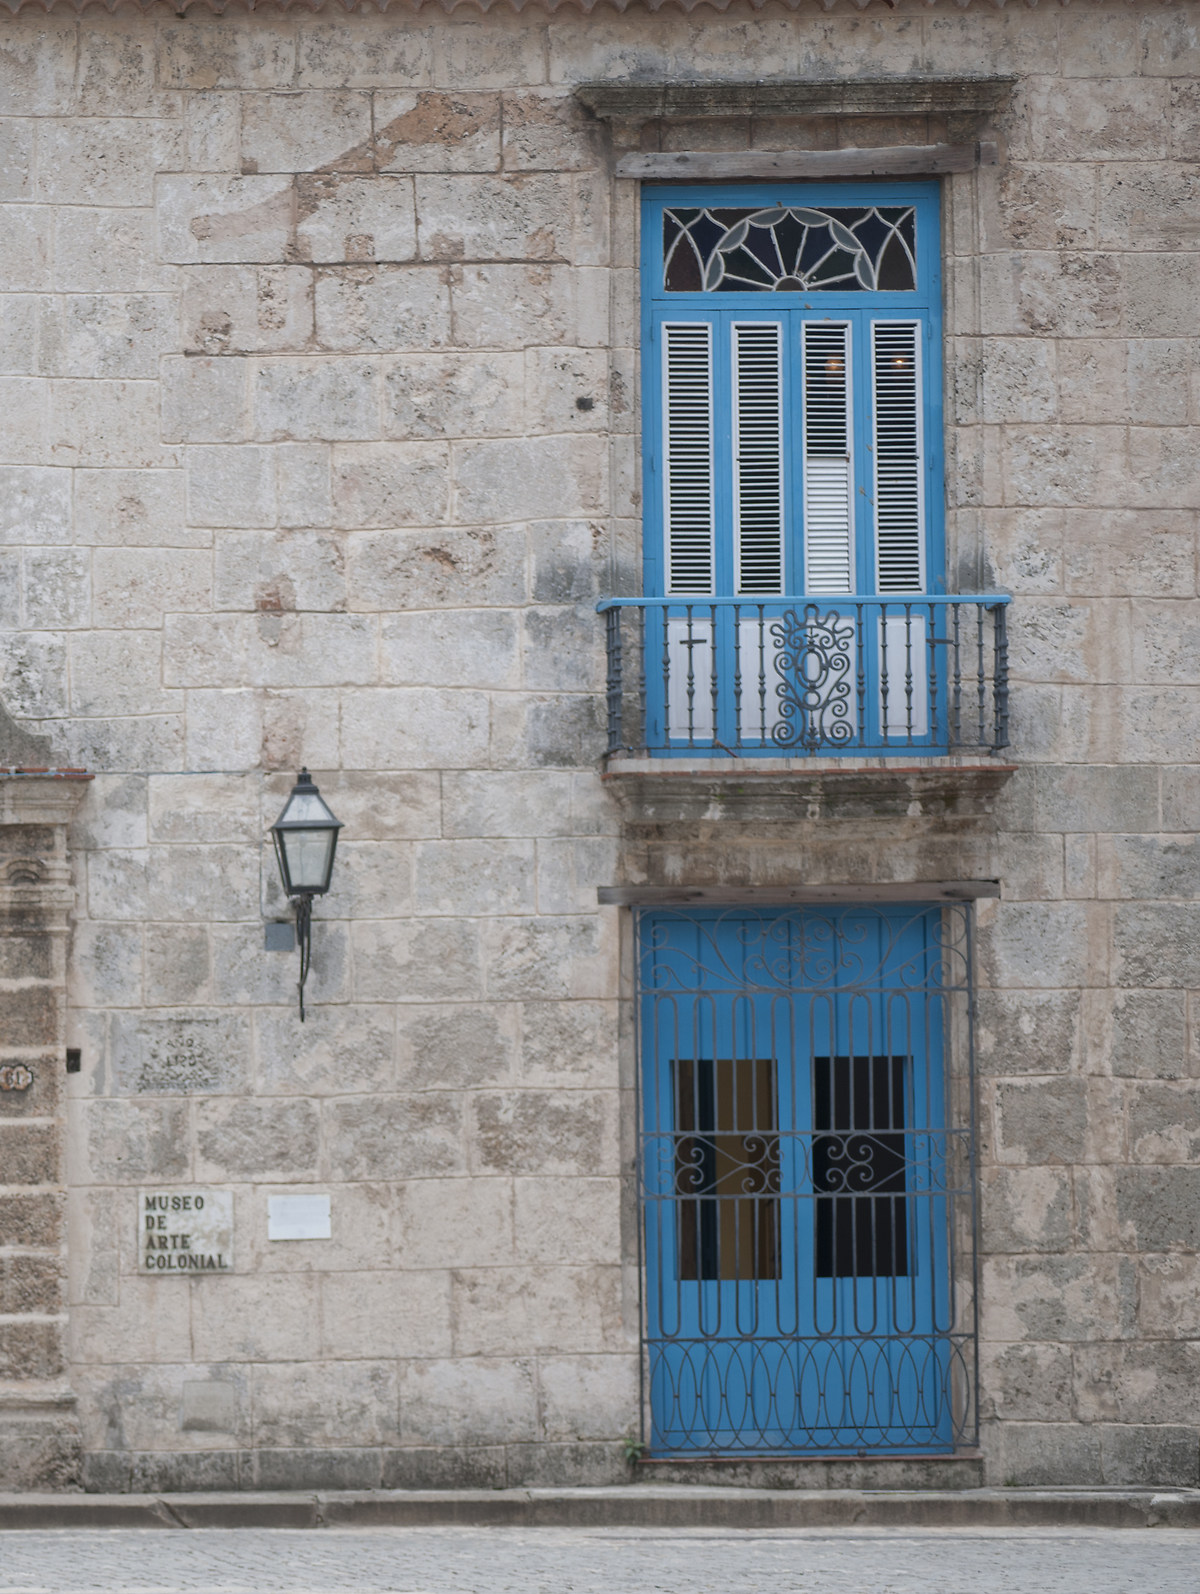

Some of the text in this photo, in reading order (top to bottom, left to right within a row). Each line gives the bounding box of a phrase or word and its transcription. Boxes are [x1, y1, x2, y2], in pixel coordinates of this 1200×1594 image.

[145, 1196, 204, 1211] MUSEO
[145, 1215, 167, 1230] DE
[146, 1234, 191, 1250] ARTE
[145, 1253, 228, 1270] COLONIAL
